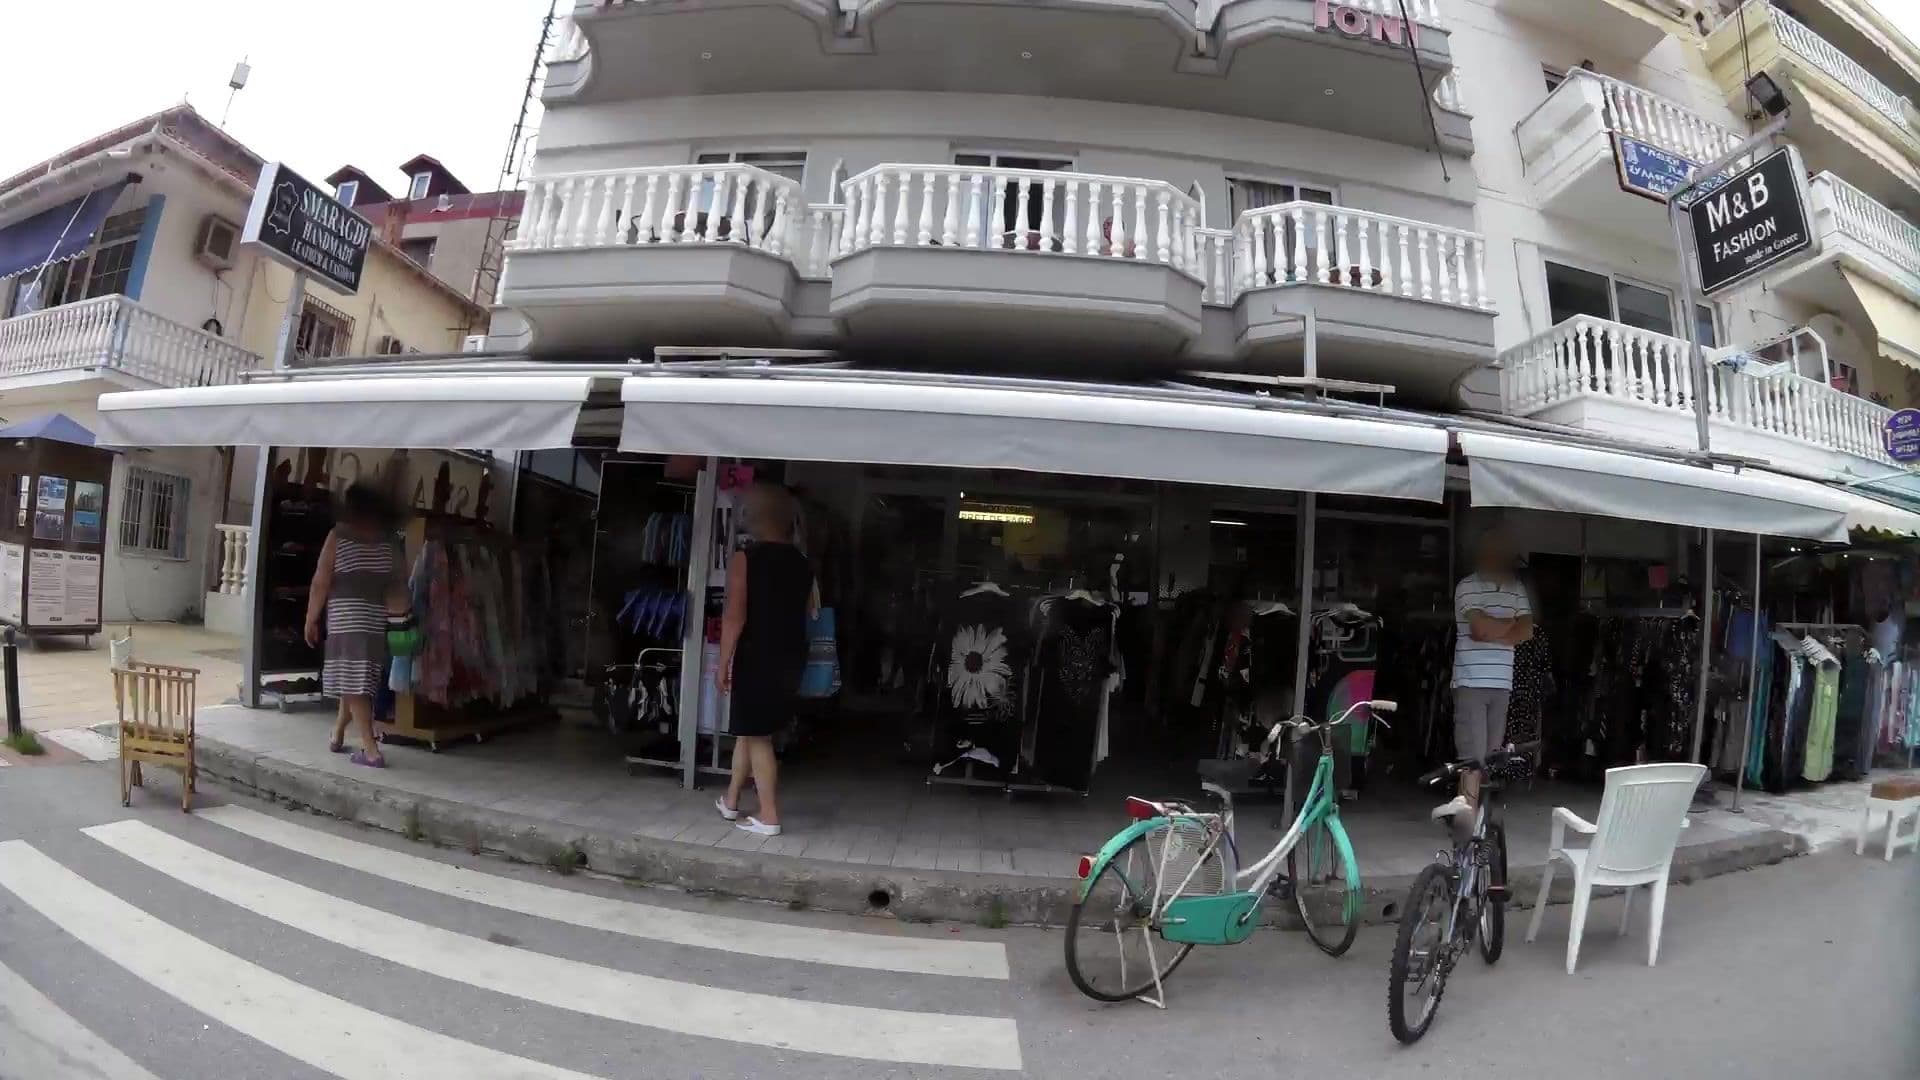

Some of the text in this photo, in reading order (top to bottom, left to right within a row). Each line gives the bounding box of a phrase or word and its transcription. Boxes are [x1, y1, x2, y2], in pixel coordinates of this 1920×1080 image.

[301, 187, 369, 250] SMARAGDI
[1711, 215, 1778, 263] FASHION
[302, 220, 355, 266] HANDMADE
